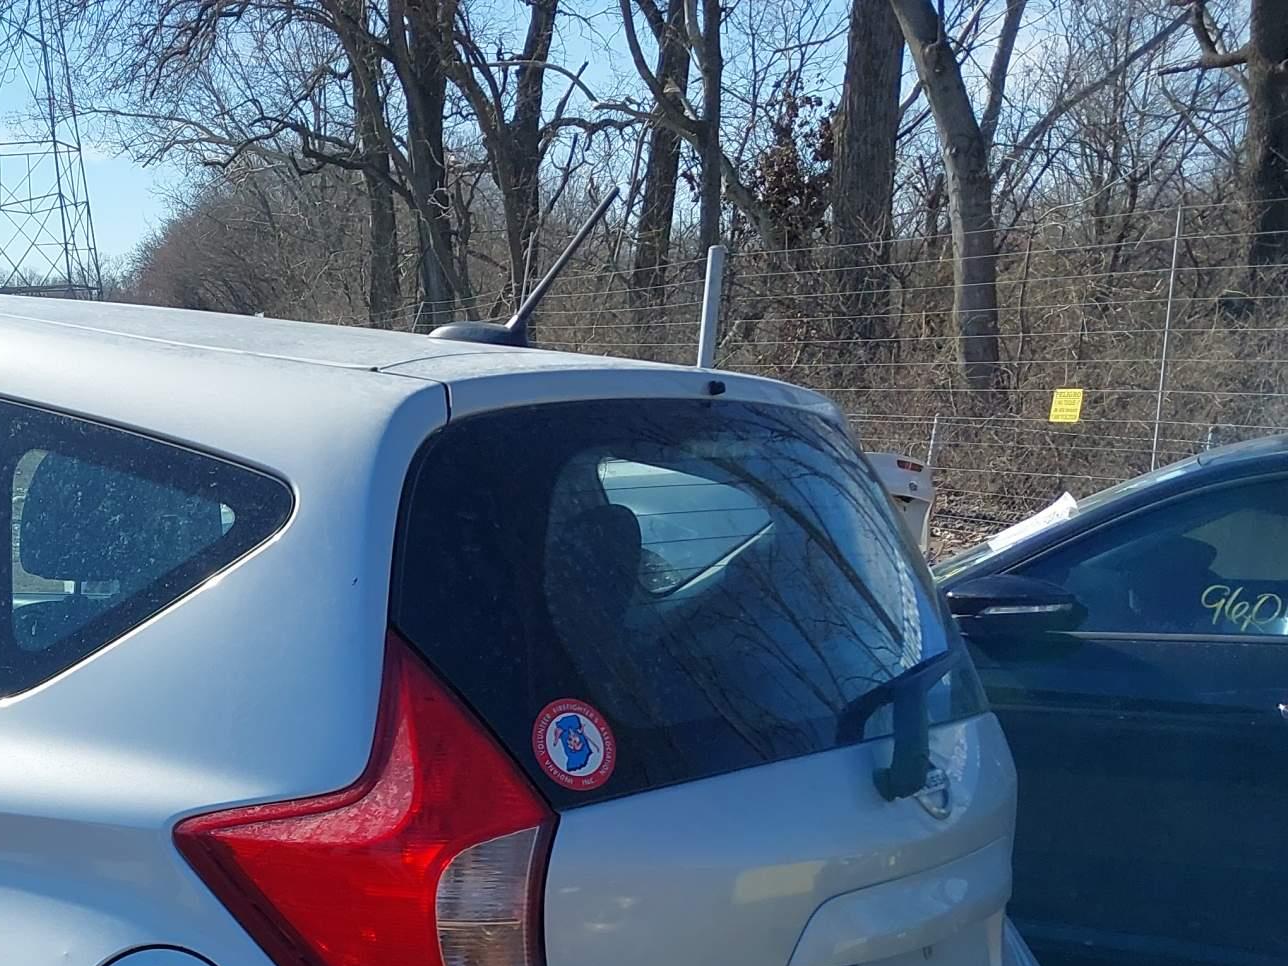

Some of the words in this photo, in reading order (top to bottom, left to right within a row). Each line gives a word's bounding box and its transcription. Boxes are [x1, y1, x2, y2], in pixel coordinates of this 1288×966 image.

[536, 713, 552, 756] VOLUNTEER
[599, 727, 612, 775] ASSOCIATION
[544, 759, 573, 785] INDIANA
